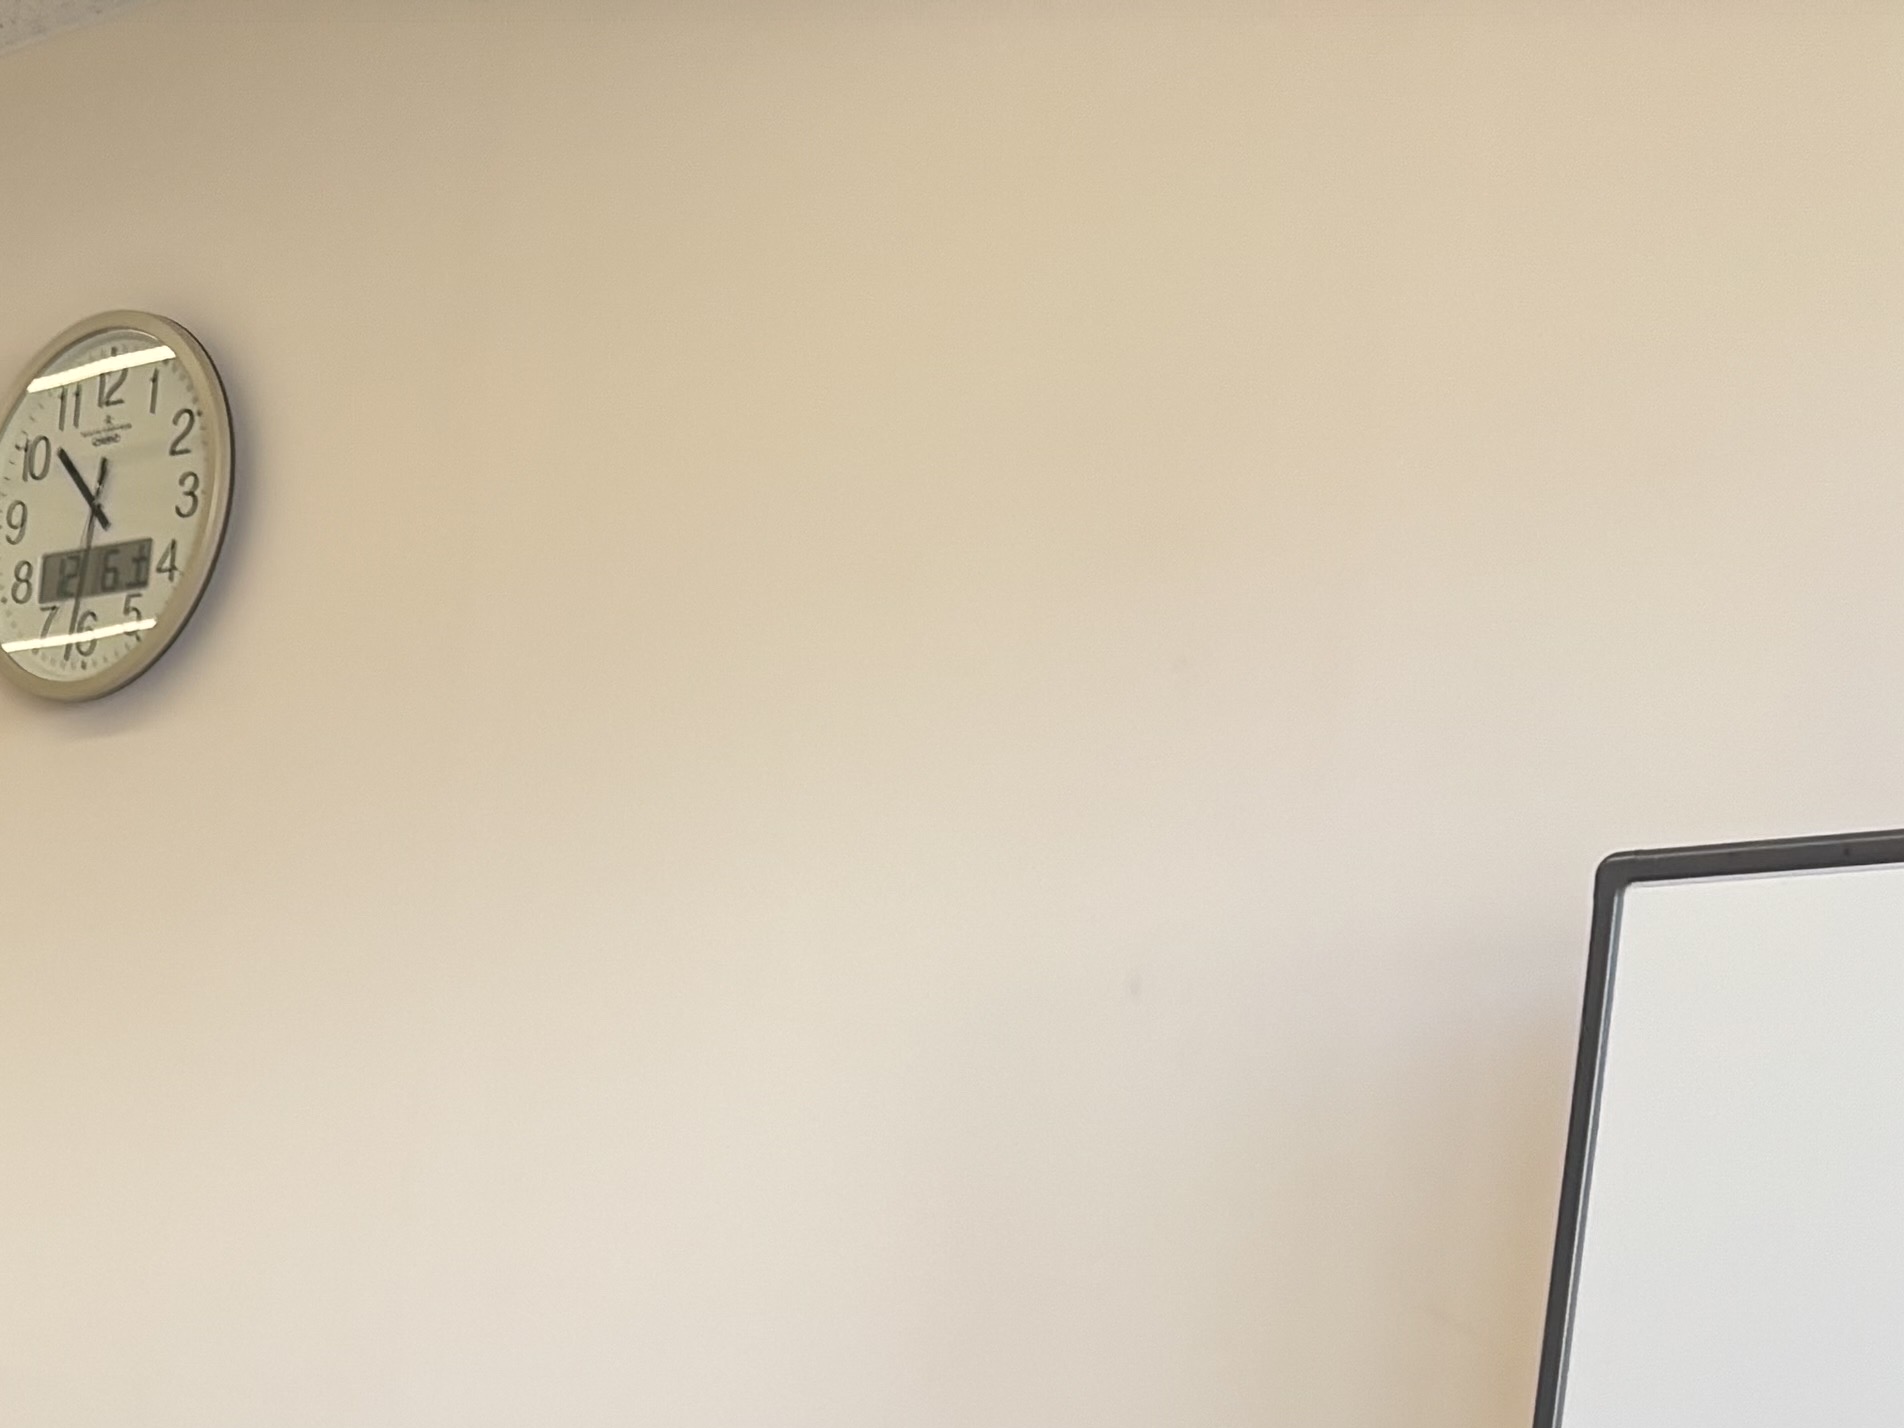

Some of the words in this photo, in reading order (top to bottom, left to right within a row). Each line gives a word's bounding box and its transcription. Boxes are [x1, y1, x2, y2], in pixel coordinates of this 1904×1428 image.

[58, 384, 82, 432] 11
[98, 366, 129, 408] 12
[149, 367, 160, 415] 1
[168, 408, 195, 457] 2
[21, 435, 52, 482] 10
[175, 471, 200, 518] 3
[5, 500, 28, 545] 9
[11, 560, 34, 605] 8
[156, 538, 179, 582] 4
[34, 604, 59, 655] 7
[75, 609, 99, 657] 6
[123, 593, 142, 637] 5
